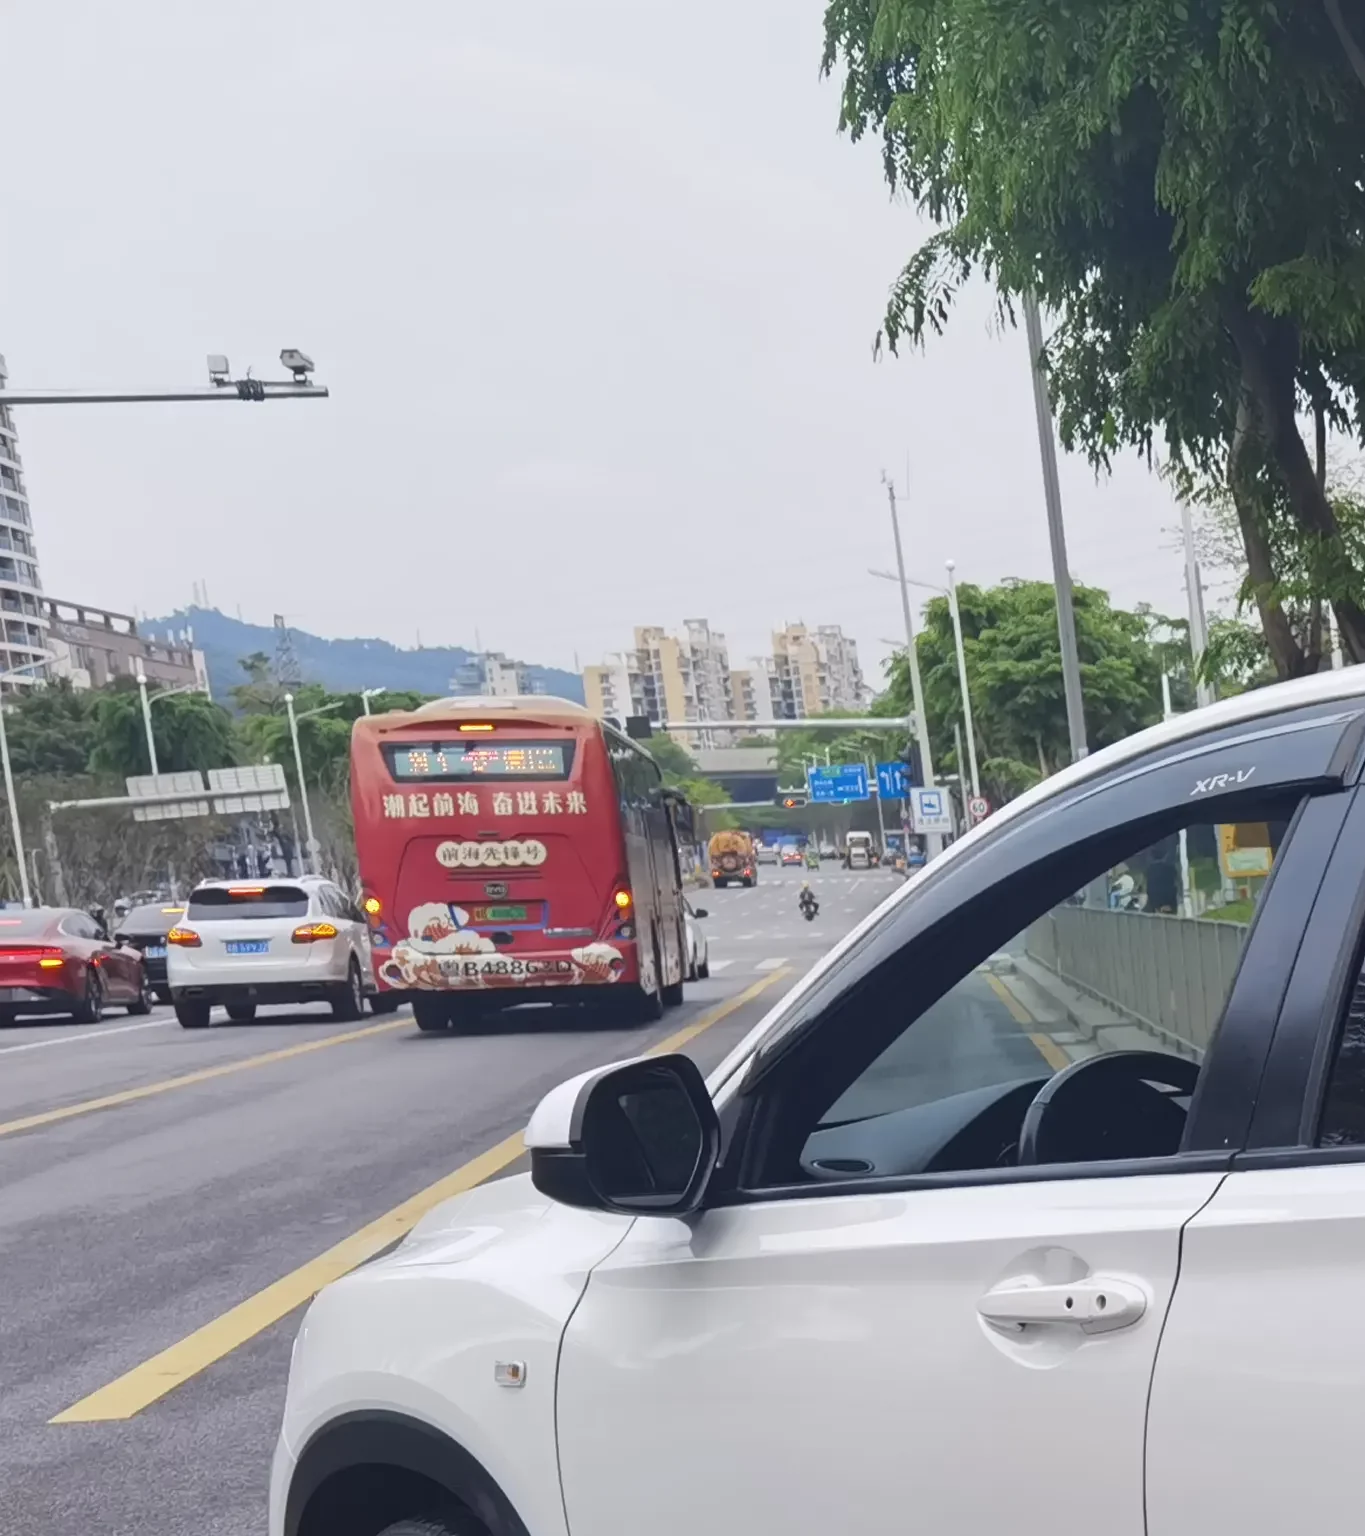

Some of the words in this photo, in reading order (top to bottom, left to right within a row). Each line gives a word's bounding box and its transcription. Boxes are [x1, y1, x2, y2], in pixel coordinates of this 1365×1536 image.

[1190, 766, 1256, 796] XR-V
[382, 791, 479, 818] 潮起前海
[492, 791, 588, 815] 奋进未来
